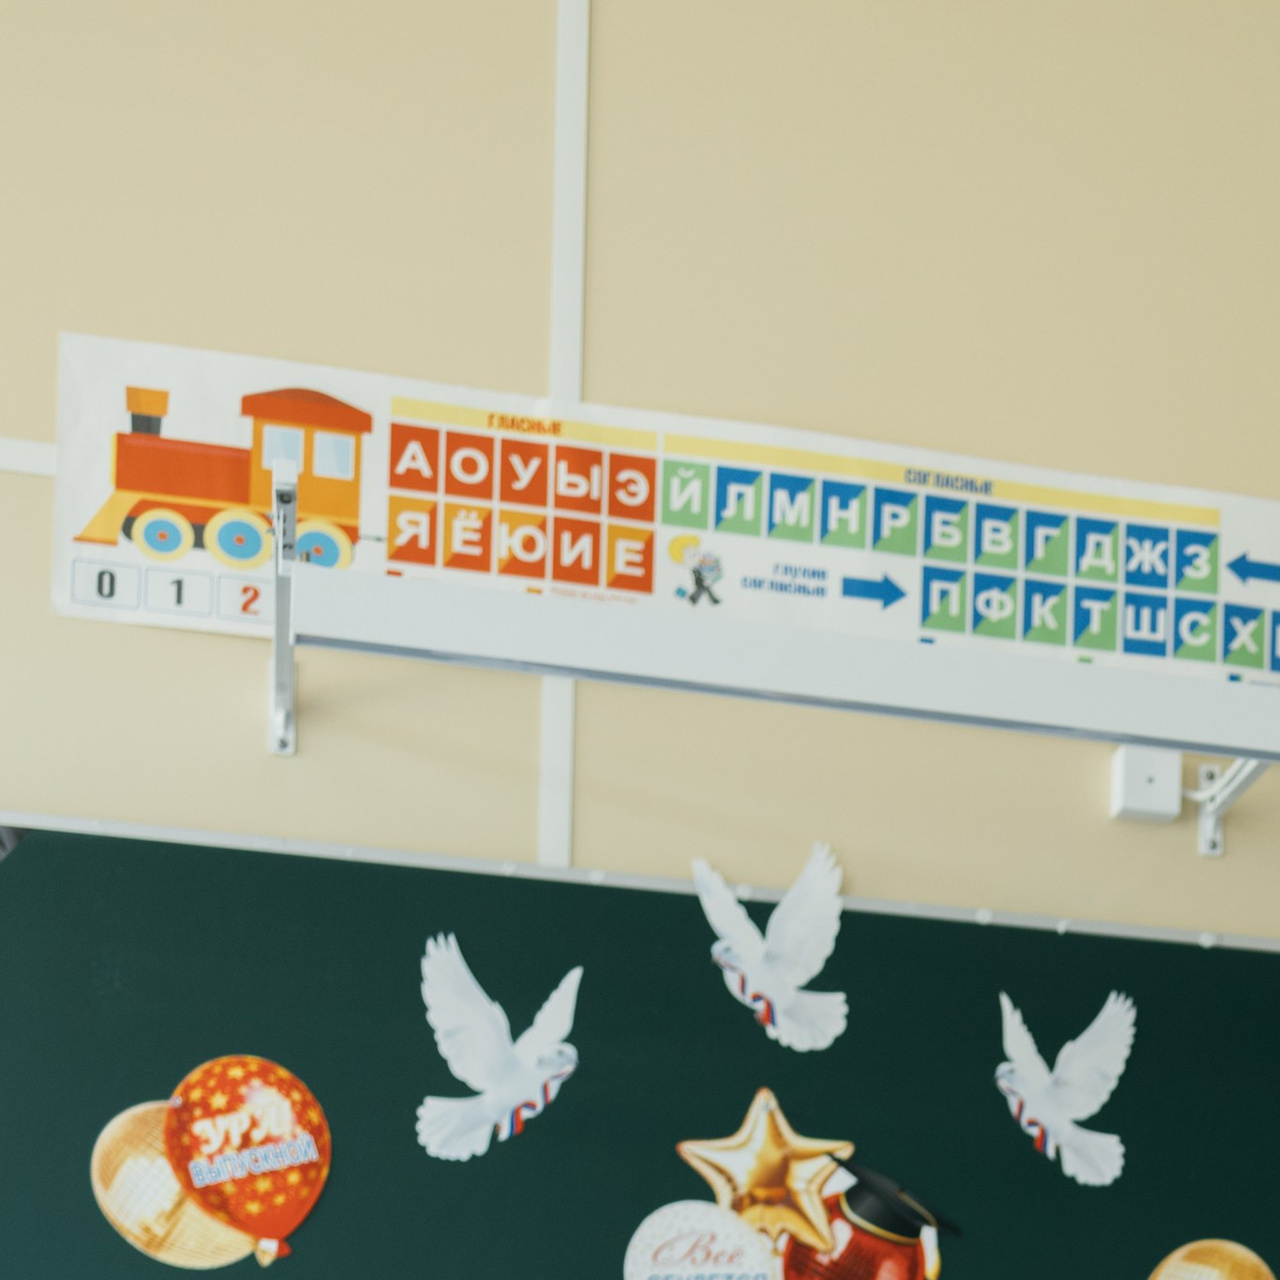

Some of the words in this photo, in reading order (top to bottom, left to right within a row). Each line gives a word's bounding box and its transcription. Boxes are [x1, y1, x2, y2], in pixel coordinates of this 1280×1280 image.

[394, 440, 433, 479] А
[450, 447, 489, 484] О
[508, 453, 542, 491] У
[556, 460, 601, 500] Ы
[615, 469, 650, 506] Э
[394, 510, 431, 549] Я
[452, 510, 484, 556] Ё
[497, 523, 546, 563] Ю
[560, 531, 593, 570] И
[613, 538, 646, 577] Е
[669, 467, 702, 515] Й
[721, 483, 755, 521] Л
[773, 488, 811, 528] М
[828, 496, 860, 534] Н
[881, 503, 910, 539] Р
[931, 511, 963, 547] Б
[981, 518, 1014, 554] В
[1033, 525, 1062, 560] Г
[1079, 533, 1115, 575] Д
[1125, 537, 1169, 575] Ж
[1182, 544, 1212, 579] З
[96, 570, 115, 599] 0
[170, 578, 184, 605] 1
[240, 585, 261, 616] 2
[929, 579, 960, 617] П
[975, 587, 1015, 623] Ф
[1031, 593, 1059, 630] К
[1080, 599, 1111, 635] Т
[1126, 604, 1167, 642] Ш
[1179, 612, 1211, 647] С
[1228, 616, 1259, 654] Х
[188, 1131, 320, 1189] ВЫПУСКНОЙ
